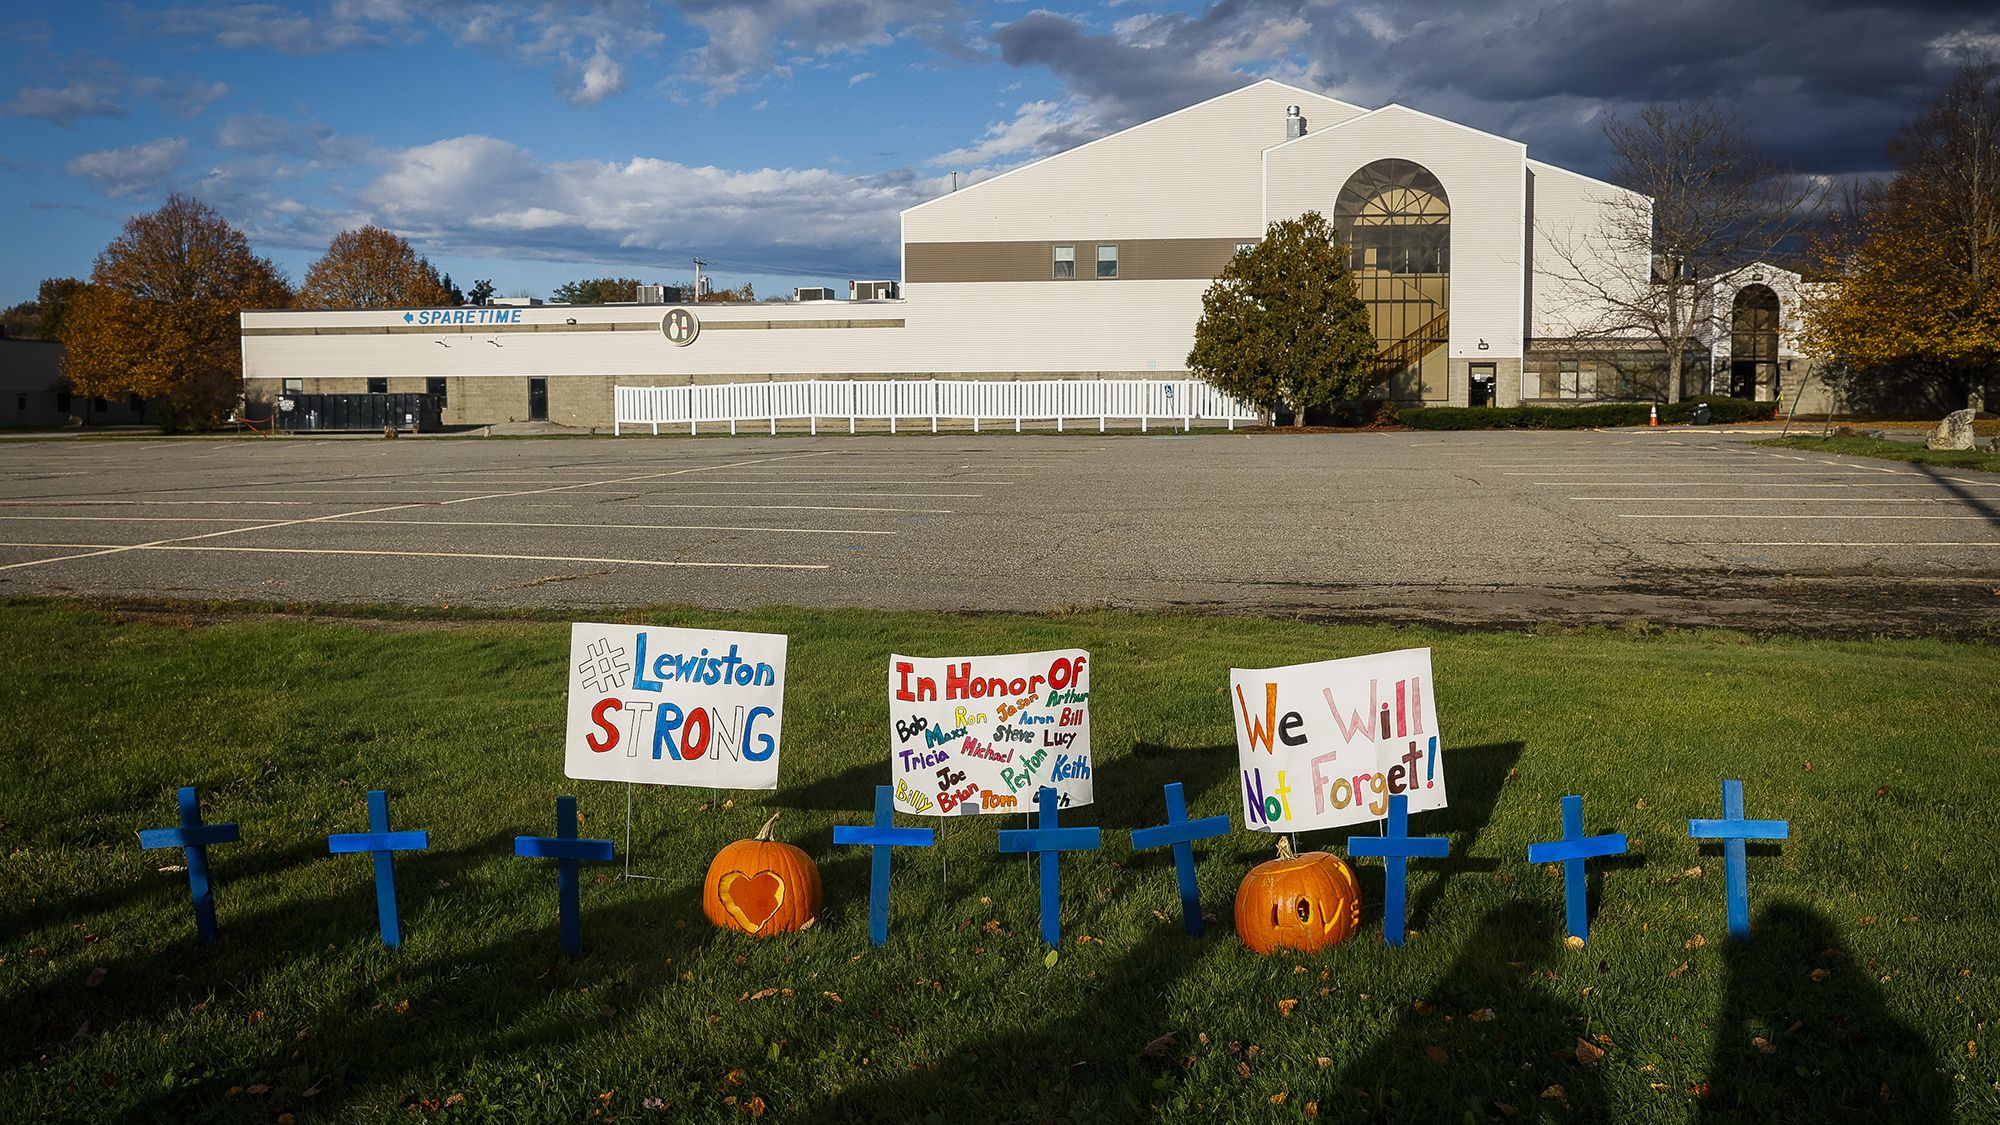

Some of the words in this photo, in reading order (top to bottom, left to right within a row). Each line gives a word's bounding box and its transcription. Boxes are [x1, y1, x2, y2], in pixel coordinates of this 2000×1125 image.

[418, 309, 523, 325] SPARETIME
[579, 632, 774, 693] #Lewiston
[896, 662, 937, 702] In
[946, 662, 1046, 700] Honor
[1048, 656, 1086, 690] Of
[996, 693, 1039, 722] Jason
[1045, 689, 1089, 707] Arthur
[586, 697, 775, 762] STRONG
[895, 715, 928, 743] Bob
[955, 706, 987, 728] Ron
[1018, 711, 1055, 725] Aaron
[1059, 707, 1084, 727] Bill
[1236, 683, 1308, 755] We
[1322, 677, 1424, 744] Will
[925, 723, 968, 749] Maxx
[993, 724, 1036, 744] Steve
[1043, 730, 1077, 749] Lucy
[899, 749, 950, 772] Tricia
[960, 736, 1014, 763] Michael
[936, 767, 967, 791] Joe
[1000, 748, 1048, 793] Peyton
[1050, 754, 1091, 782] Keith
[1243, 768, 1292, 824] Not
[1311, 735, 1437, 816] Forget!
[895, 778, 933, 814] Billy
[936, 782, 980, 813] Brian
[980, 789, 1018, 809] Tom
